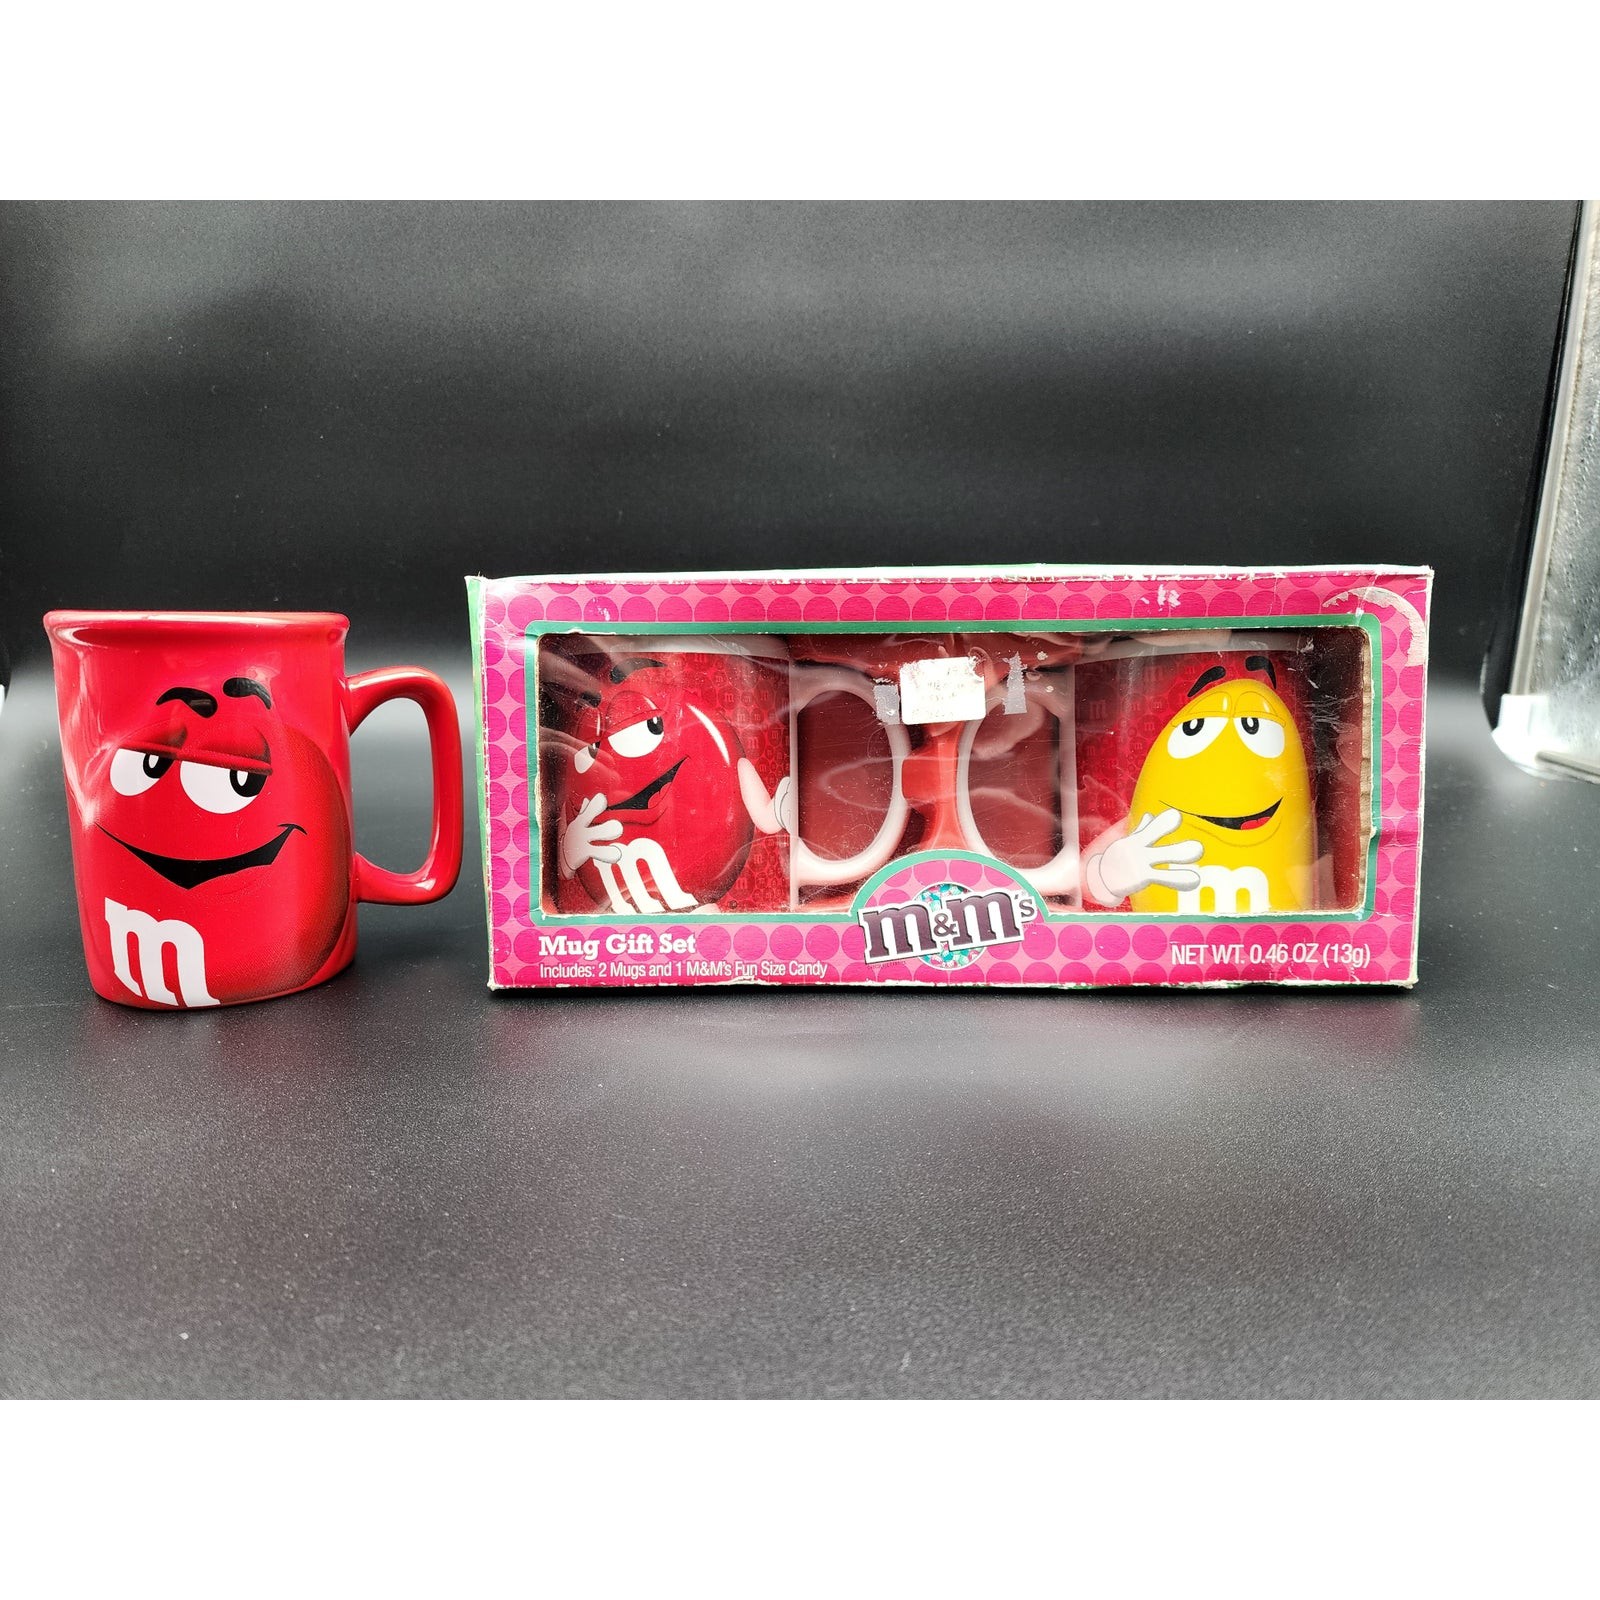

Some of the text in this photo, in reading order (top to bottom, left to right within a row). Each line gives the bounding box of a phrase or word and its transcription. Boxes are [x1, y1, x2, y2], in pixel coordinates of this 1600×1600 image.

[104, 896, 221, 1008] m
[538, 933, 696, 960] Mug Gift Set
[1171, 942, 1371, 968] NET WT. 0.46 OZ (13g)
[539, 959, 828, 980] Includes: 2 Mugs and 1 M&M's Fun Size Candy
